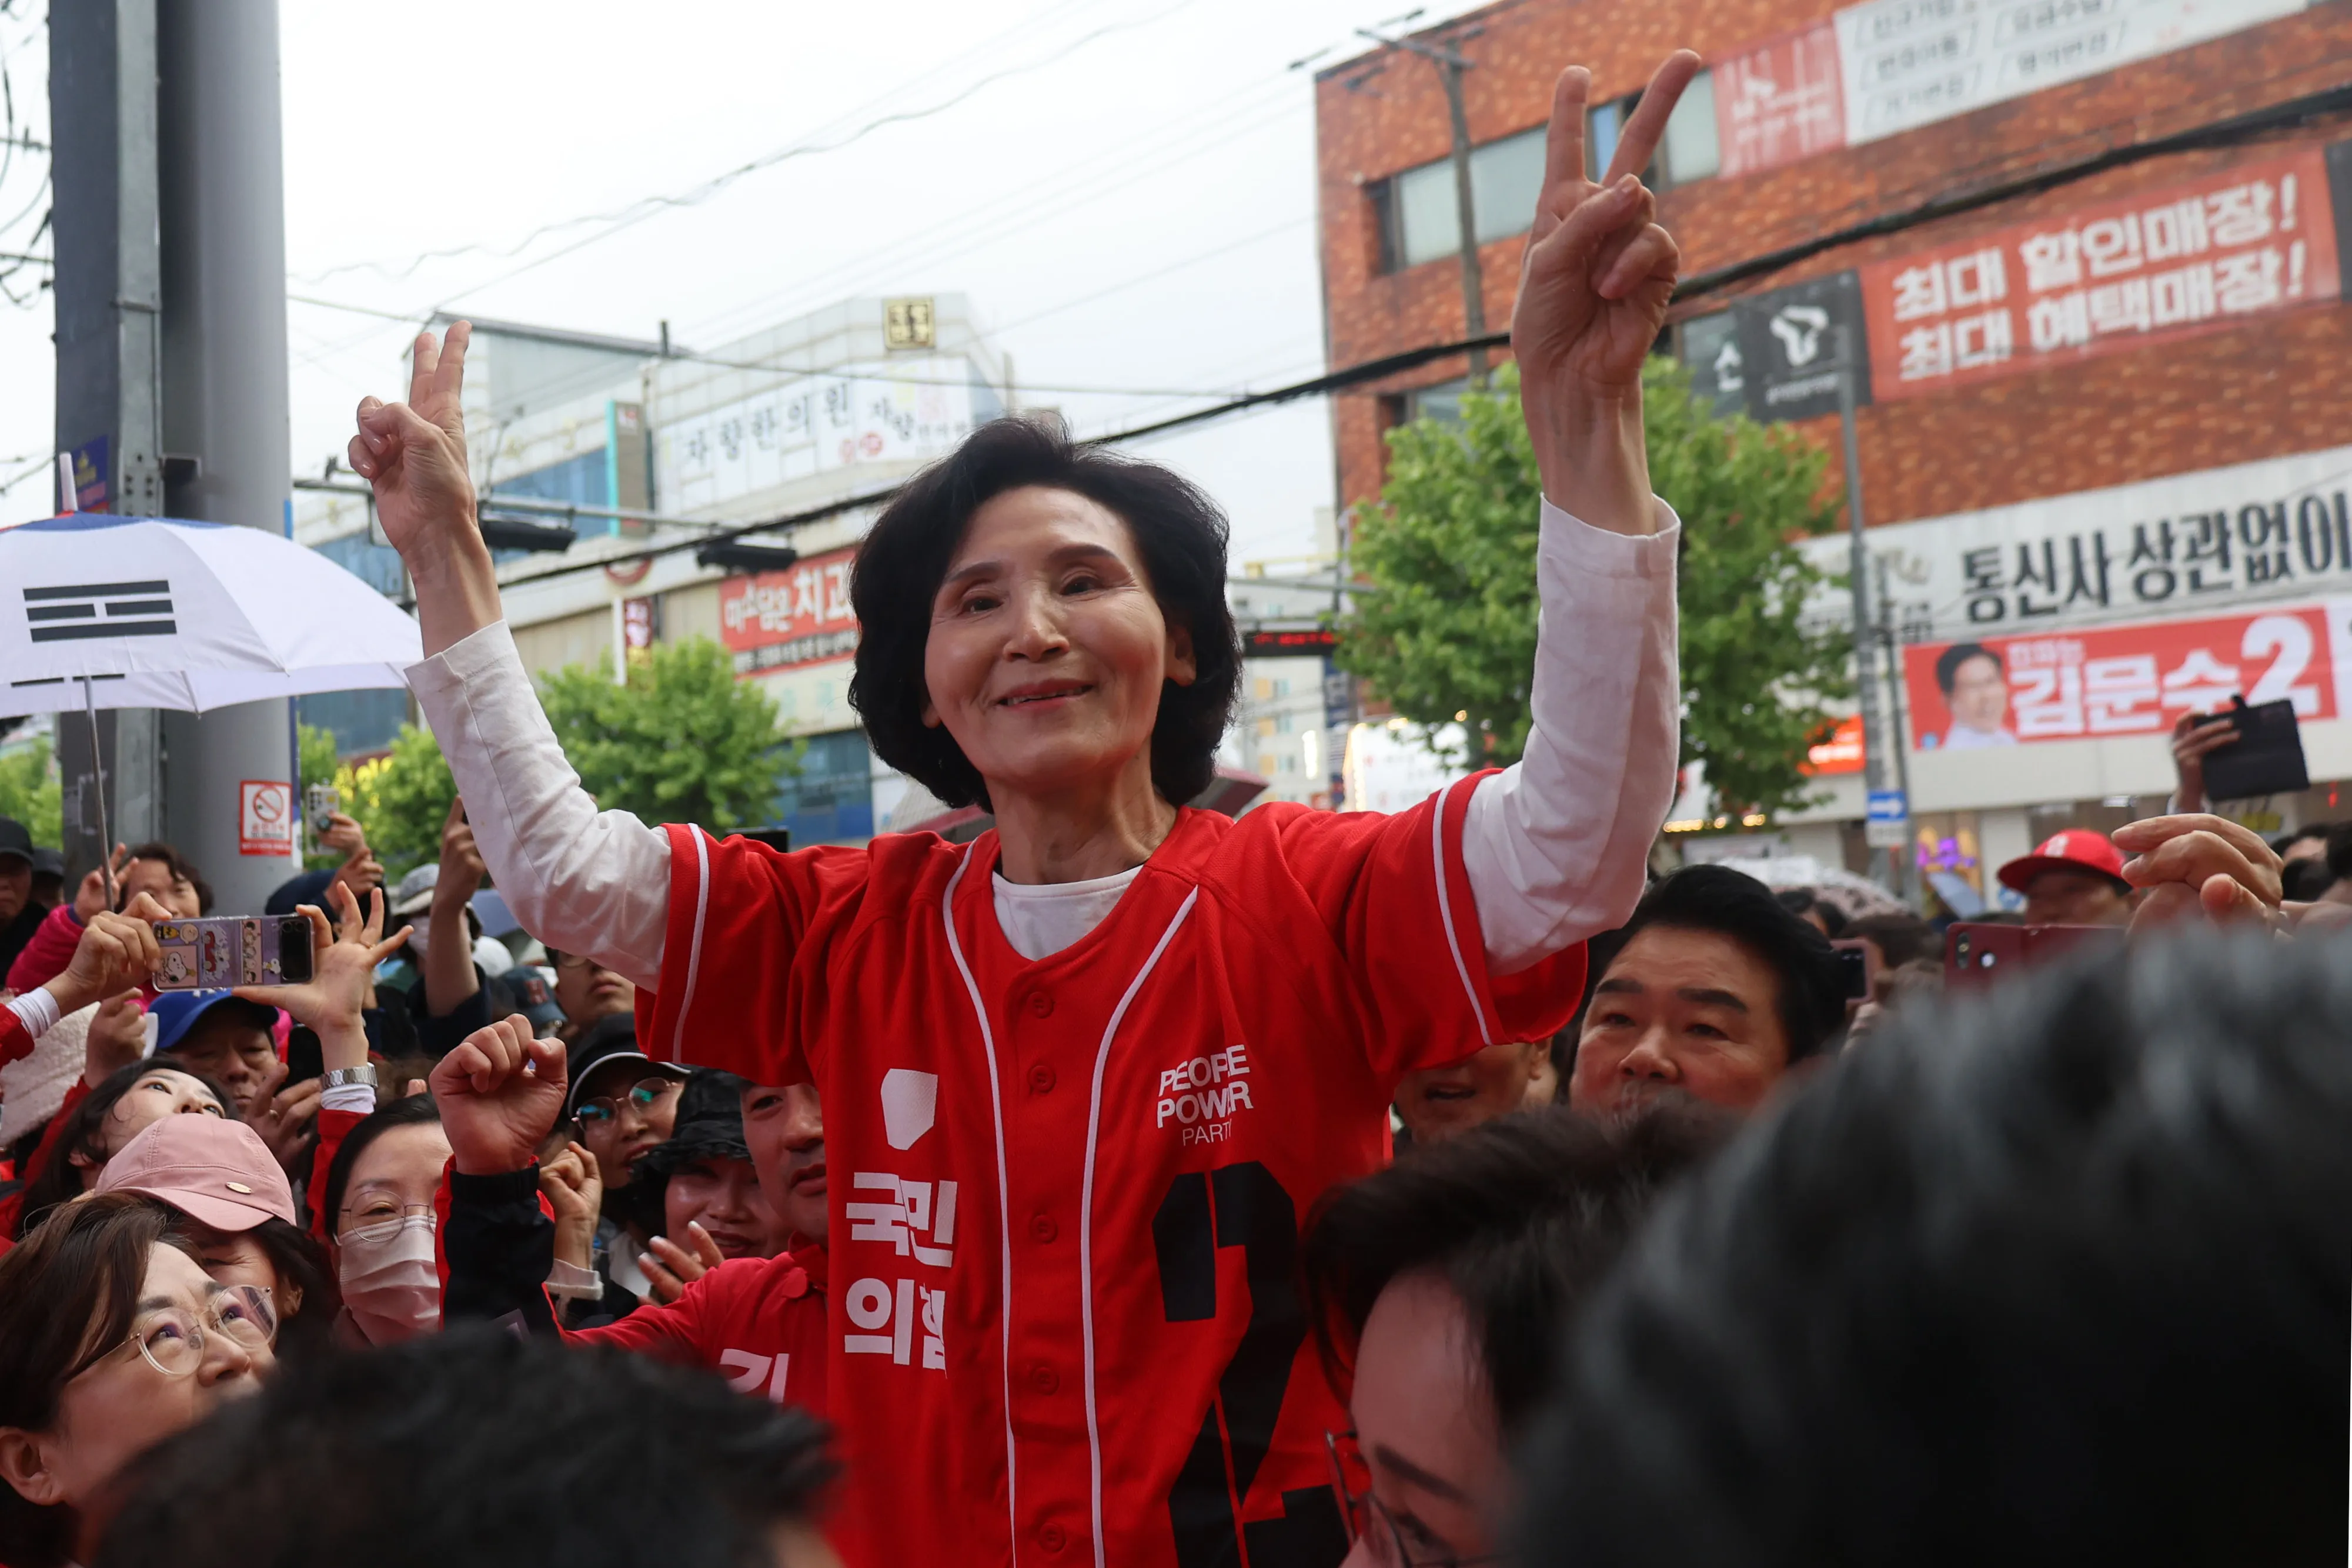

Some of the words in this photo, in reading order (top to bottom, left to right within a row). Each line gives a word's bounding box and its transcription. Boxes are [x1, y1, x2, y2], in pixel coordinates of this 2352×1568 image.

[1892, 245, 2008, 323] 최대
[2019, 173, 2297, 292] 할인매장!
[1899, 306, 2013, 382] 최대
[2026, 238, 2306, 351] 혜택매장!
[1962, 530, 2109, 624] 통신사
[2127, 490, 2351, 603] 상관없이
[2008, 648, 2240, 736] 김문수
[2240, 614, 2321, 716] 2
[1157, 1081, 1254, 1129] POWR
[1158, 1044, 1251, 1097] PEOPE
[846, 1172, 958, 1268] 국민
